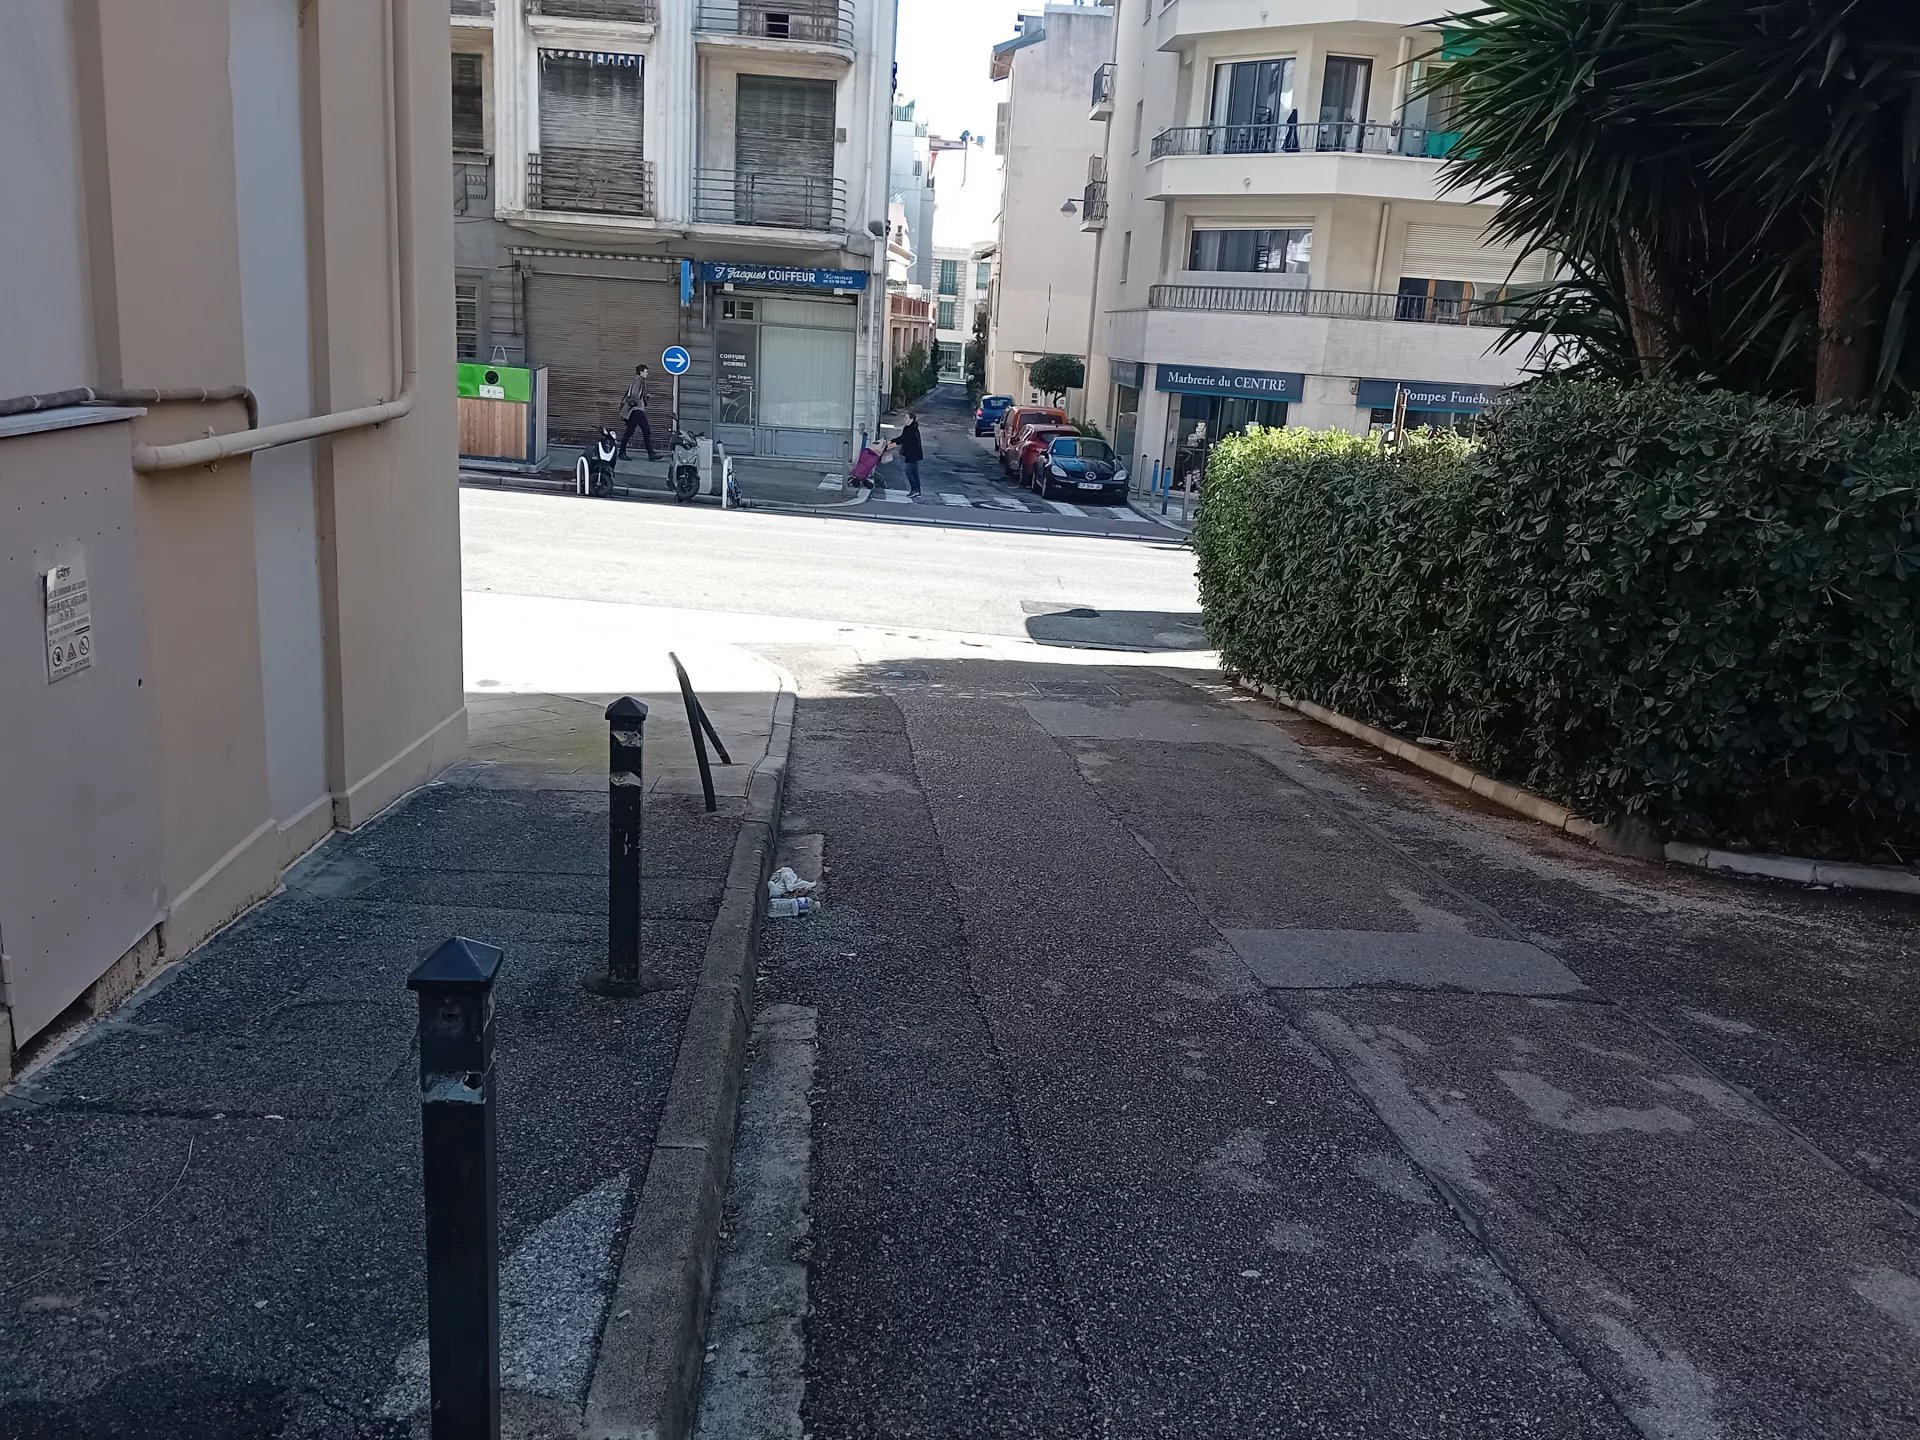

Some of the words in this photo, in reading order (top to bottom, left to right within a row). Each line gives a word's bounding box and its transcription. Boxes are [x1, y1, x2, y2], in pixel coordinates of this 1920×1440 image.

[727, 267, 766, 281] Jacques
[768, 270, 816, 283] COIFFEUR
[1168, 371, 1215, 386] Marbrerie
[1218, 375, 1231, 387] du
[1234, 376, 1286, 391] CENTRE
[1403, 388, 1447, 404] Pompes
